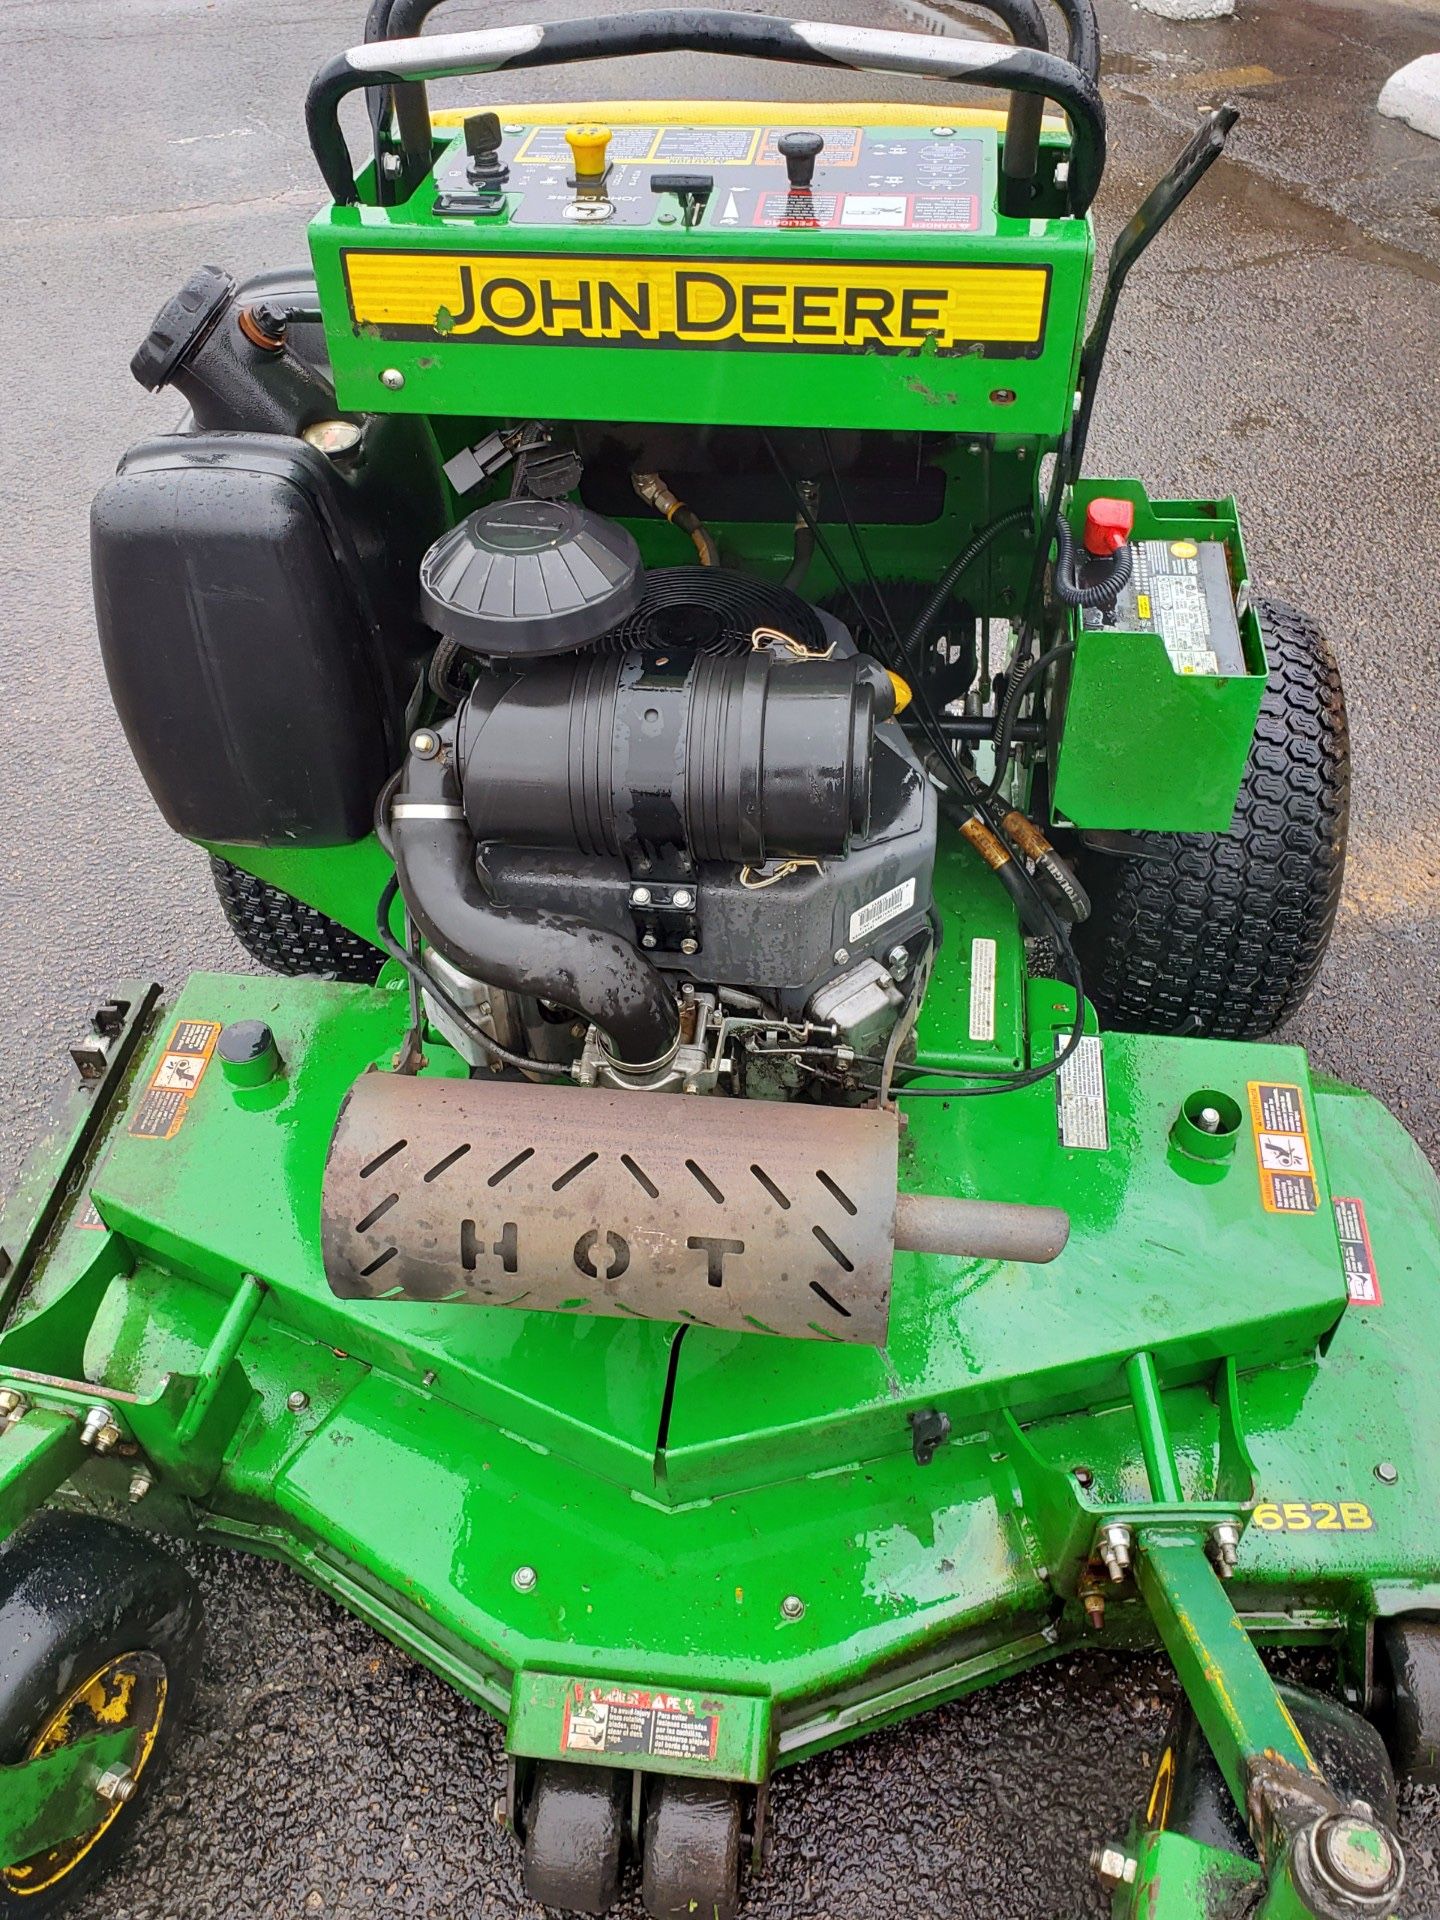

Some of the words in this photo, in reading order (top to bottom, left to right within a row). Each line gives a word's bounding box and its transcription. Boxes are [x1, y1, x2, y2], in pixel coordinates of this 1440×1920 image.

[450, 265, 652, 332] JOHN
[676, 271, 952, 341] DEERE
[461, 1219, 746, 1288] HOT
[1252, 1502, 1374, 1531] 652B
[623, 1716, 645, 1725] rotating
[634, 1710, 650, 1718] injury
